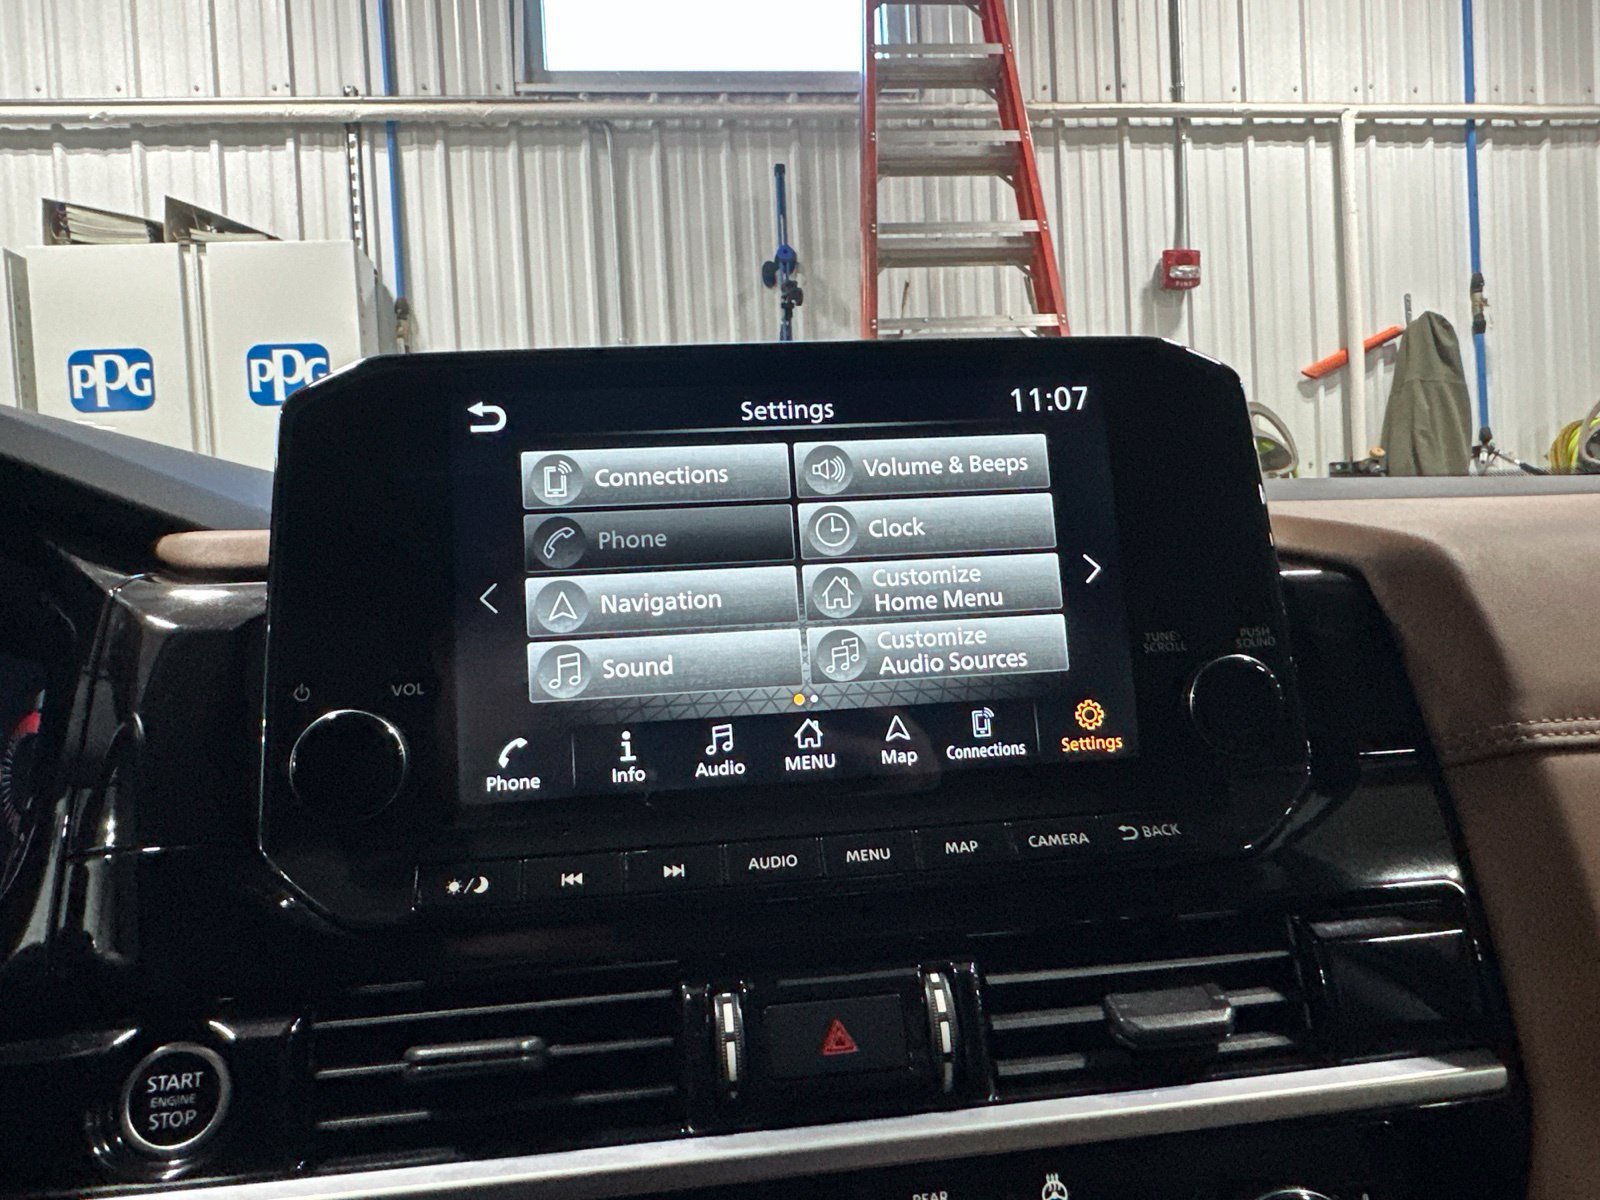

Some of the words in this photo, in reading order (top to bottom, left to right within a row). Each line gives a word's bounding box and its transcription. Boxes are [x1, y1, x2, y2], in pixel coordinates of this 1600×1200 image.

[71, 354, 154, 408] PPG
[1010, 385, 1088, 413] 11:07
[740, 399, 835, 424] Settings
[862, 457, 943, 477] Volume
[948, 455, 964, 473] &
[969, 455, 1029, 477] Beeps
[594, 465, 729, 488] Connections
[868, 516, 926, 538] Clock
[598, 530, 667, 550] Phone
[872, 566, 982, 587] Customize
[600, 590, 722, 617] Navigation
[874, 592, 938, 613] Home
[943, 588, 1004, 610] Menu
[876, 629, 988, 650] Customize
[1239, 626, 1271, 637] PUSH
[1143, 640, 1188, 654] SCROLL
[1235, 636, 1277, 649] SOUND
[602, 654, 674, 679] Sound
[879, 654, 945, 675] Audio
[948, 651, 1029, 672] Sources
[391, 682, 425, 696] VOL
[945, 742, 1027, 760] Connections
[1061, 735, 1123, 753] Settings
[784, 752, 836, 771] MENU
[881, 749, 918, 767] Map
[611, 765, 647, 783] Info
[694, 759, 746, 778] Audio
[486, 774, 541, 793] Phone
[1028, 832, 1090, 848] CAMERA
[1141, 823, 1181, 838] BACK
[846, 847, 891, 863] MENU
[945, 840, 979, 855] MAP
[748, 854, 798, 870] AUDIO
[147, 1071, 204, 1093] START
[150, 1093, 197, 1109] ENGINE
[149, 1109, 198, 1131] STOP
